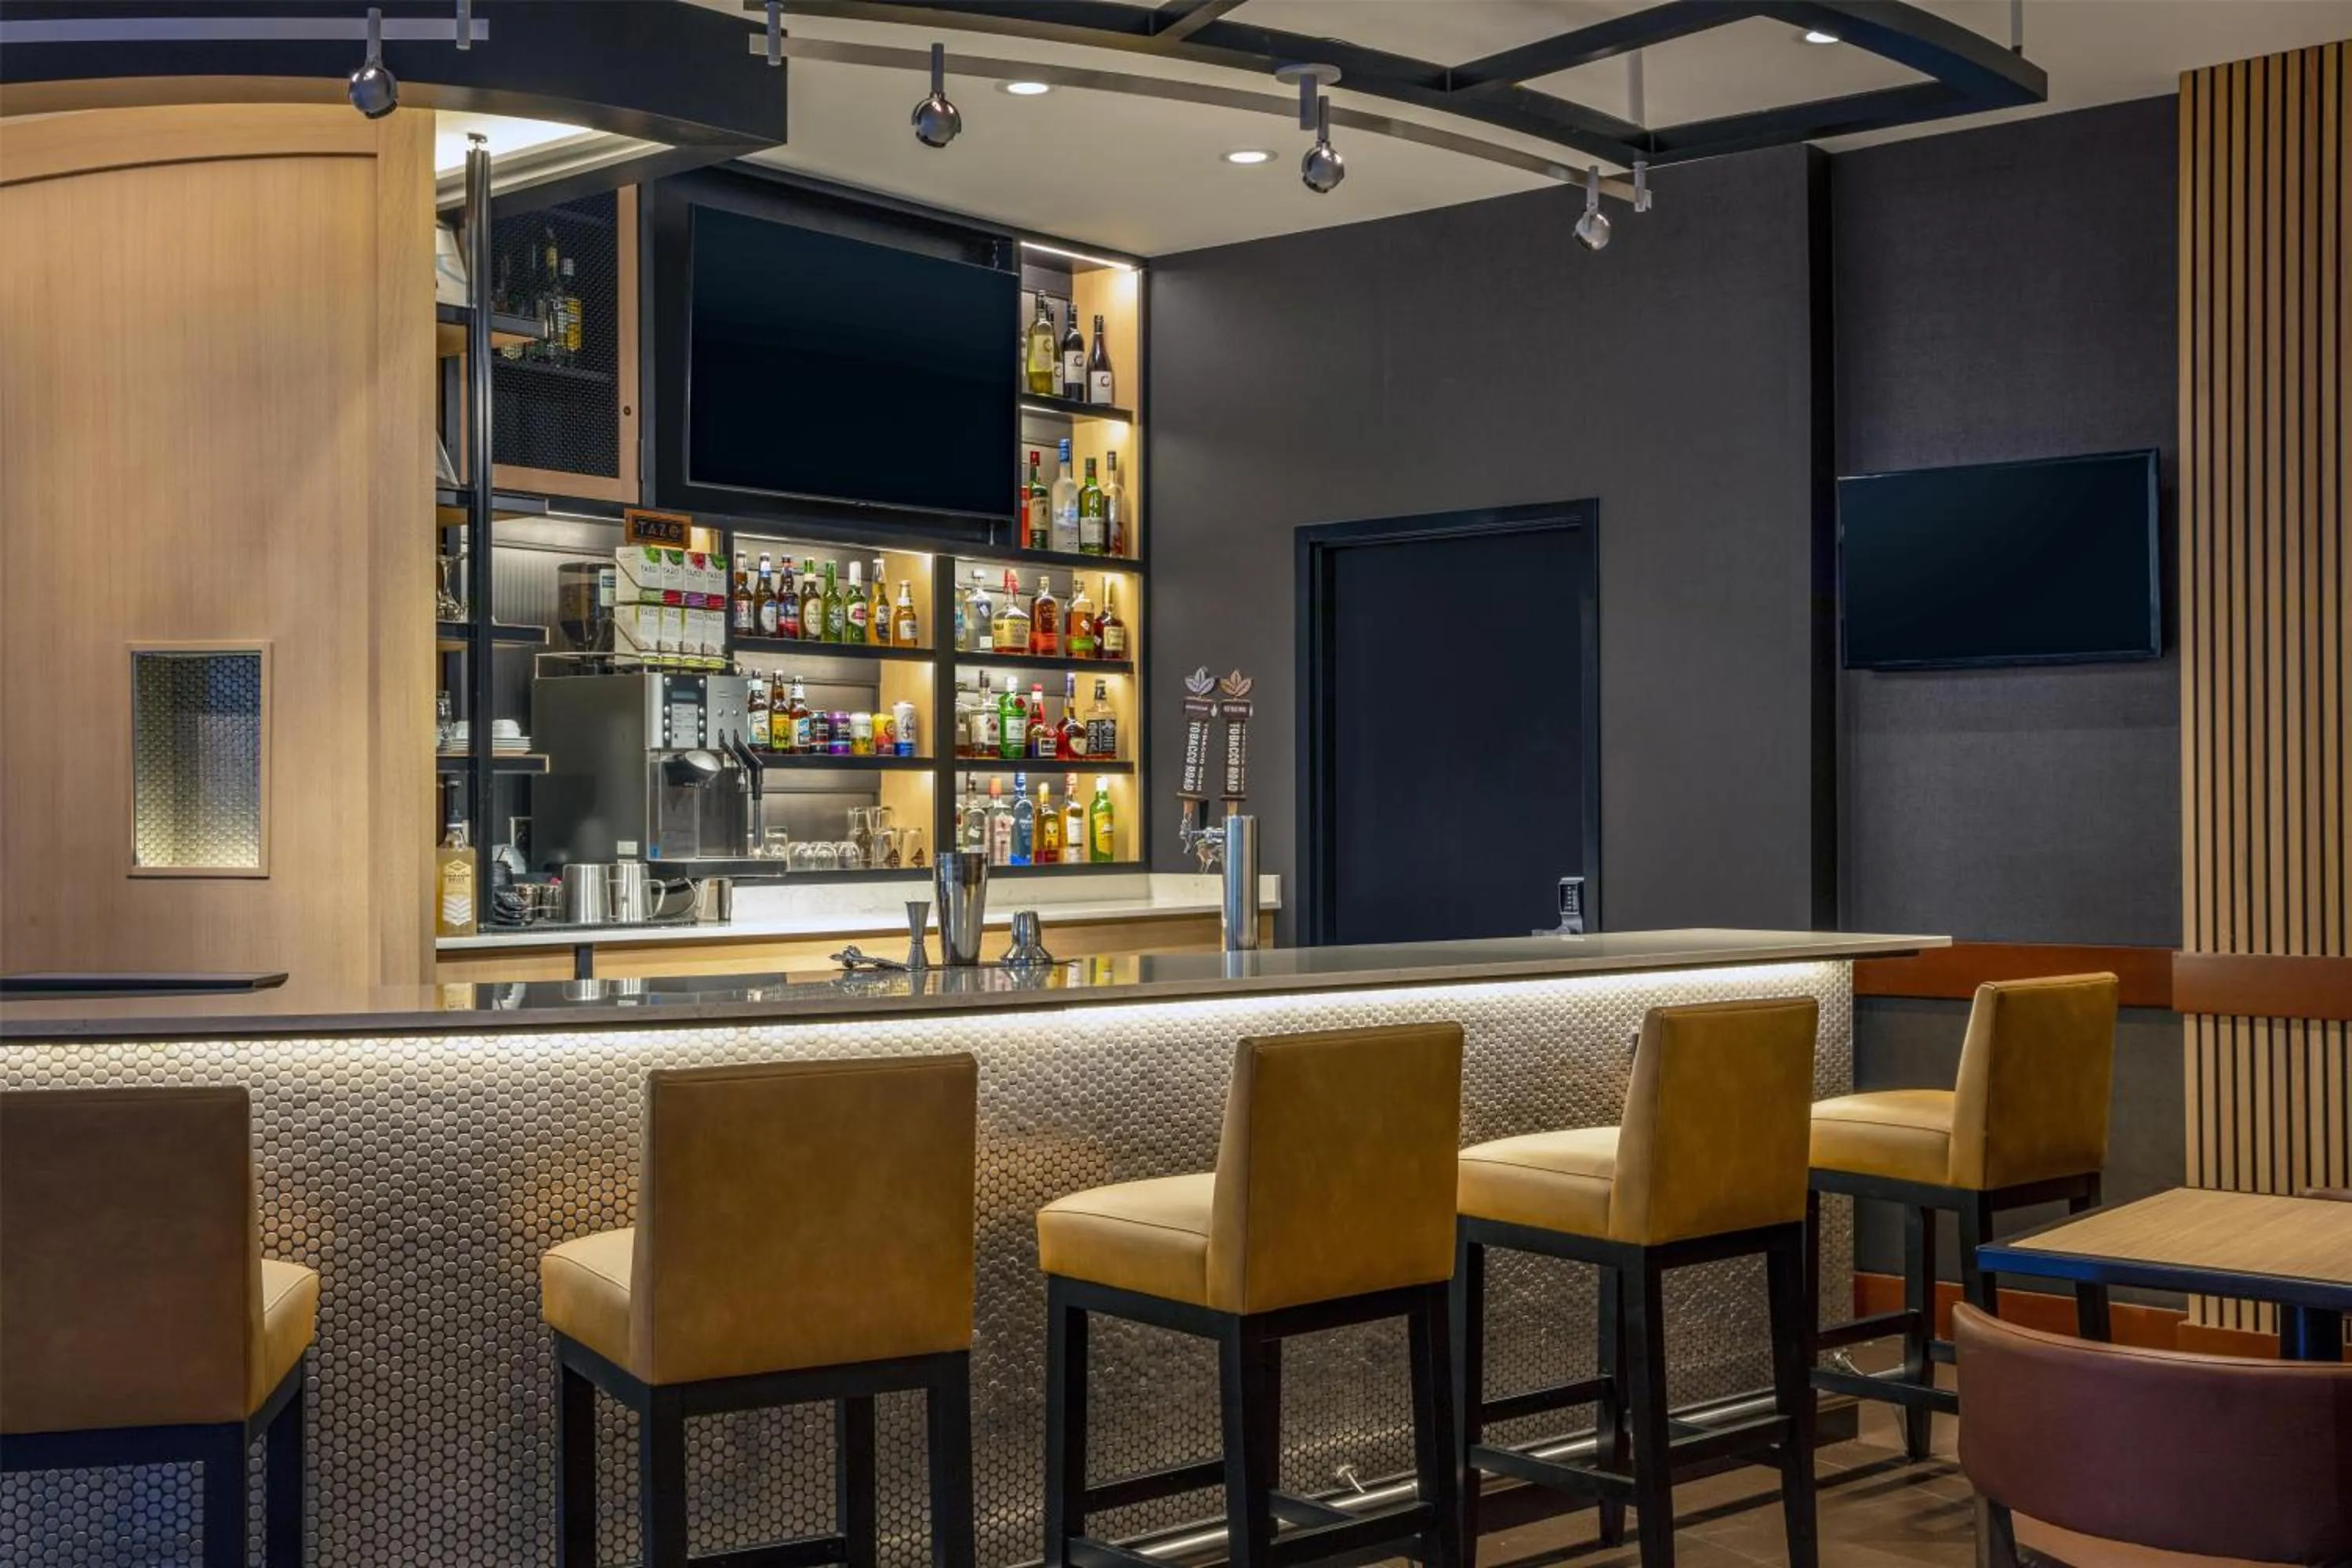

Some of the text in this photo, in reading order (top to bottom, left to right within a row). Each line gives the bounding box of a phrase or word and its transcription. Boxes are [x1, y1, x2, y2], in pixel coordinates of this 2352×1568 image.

[637, 519, 679, 539] TAZO
[1186, 722, 1201, 764] TOBACCO
[1228, 723, 1240, 766] TOBACCO
[1183, 765, 1196, 791] ROAD
[1227, 767, 1240, 792] ROAD
